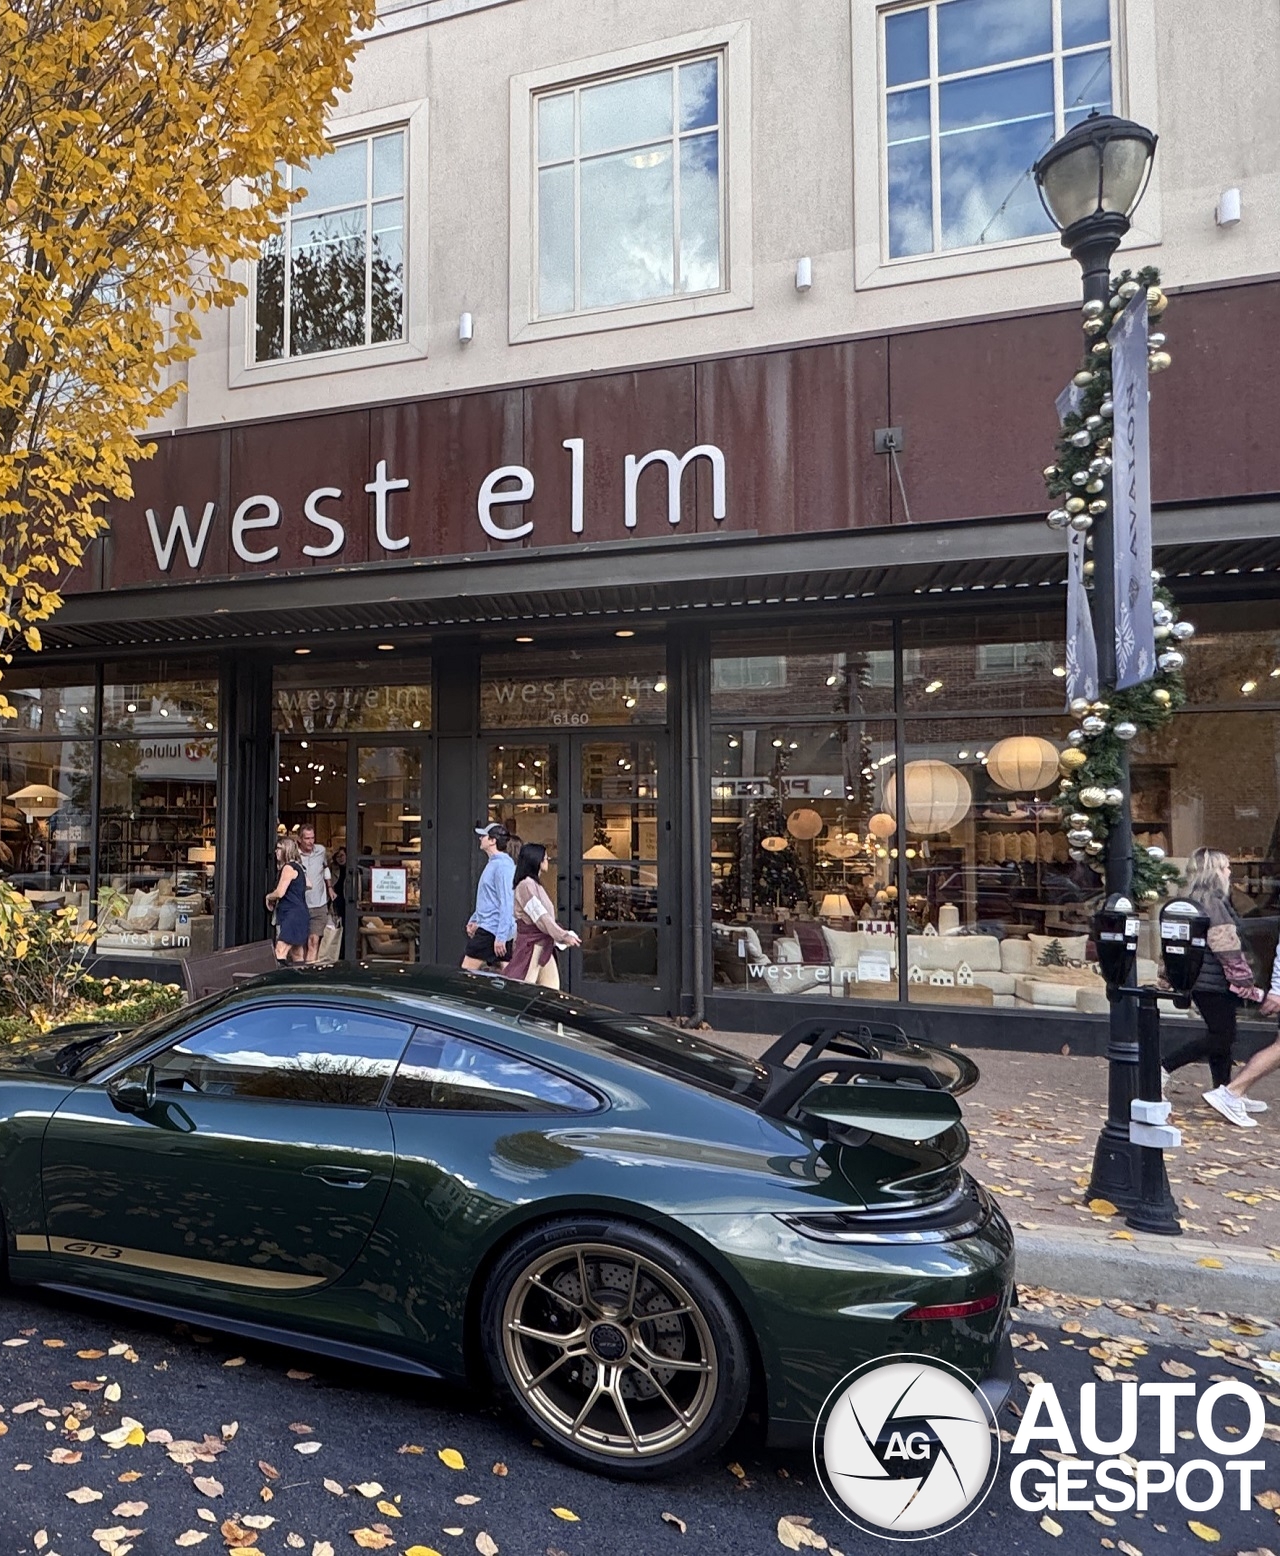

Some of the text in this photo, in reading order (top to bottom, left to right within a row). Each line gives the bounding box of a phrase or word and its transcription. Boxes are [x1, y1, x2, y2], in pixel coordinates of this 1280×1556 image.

[145, 437, 727, 571] west elm
[277, 685, 421, 711] west elm
[492, 678, 578, 704] west
[553, 713, 589, 725] 6160
[119, 932, 191, 947] west elm
[748, 963, 805, 980] west
[814, 965, 859, 984] elm
[63, 1242, 123, 1259] GT3
